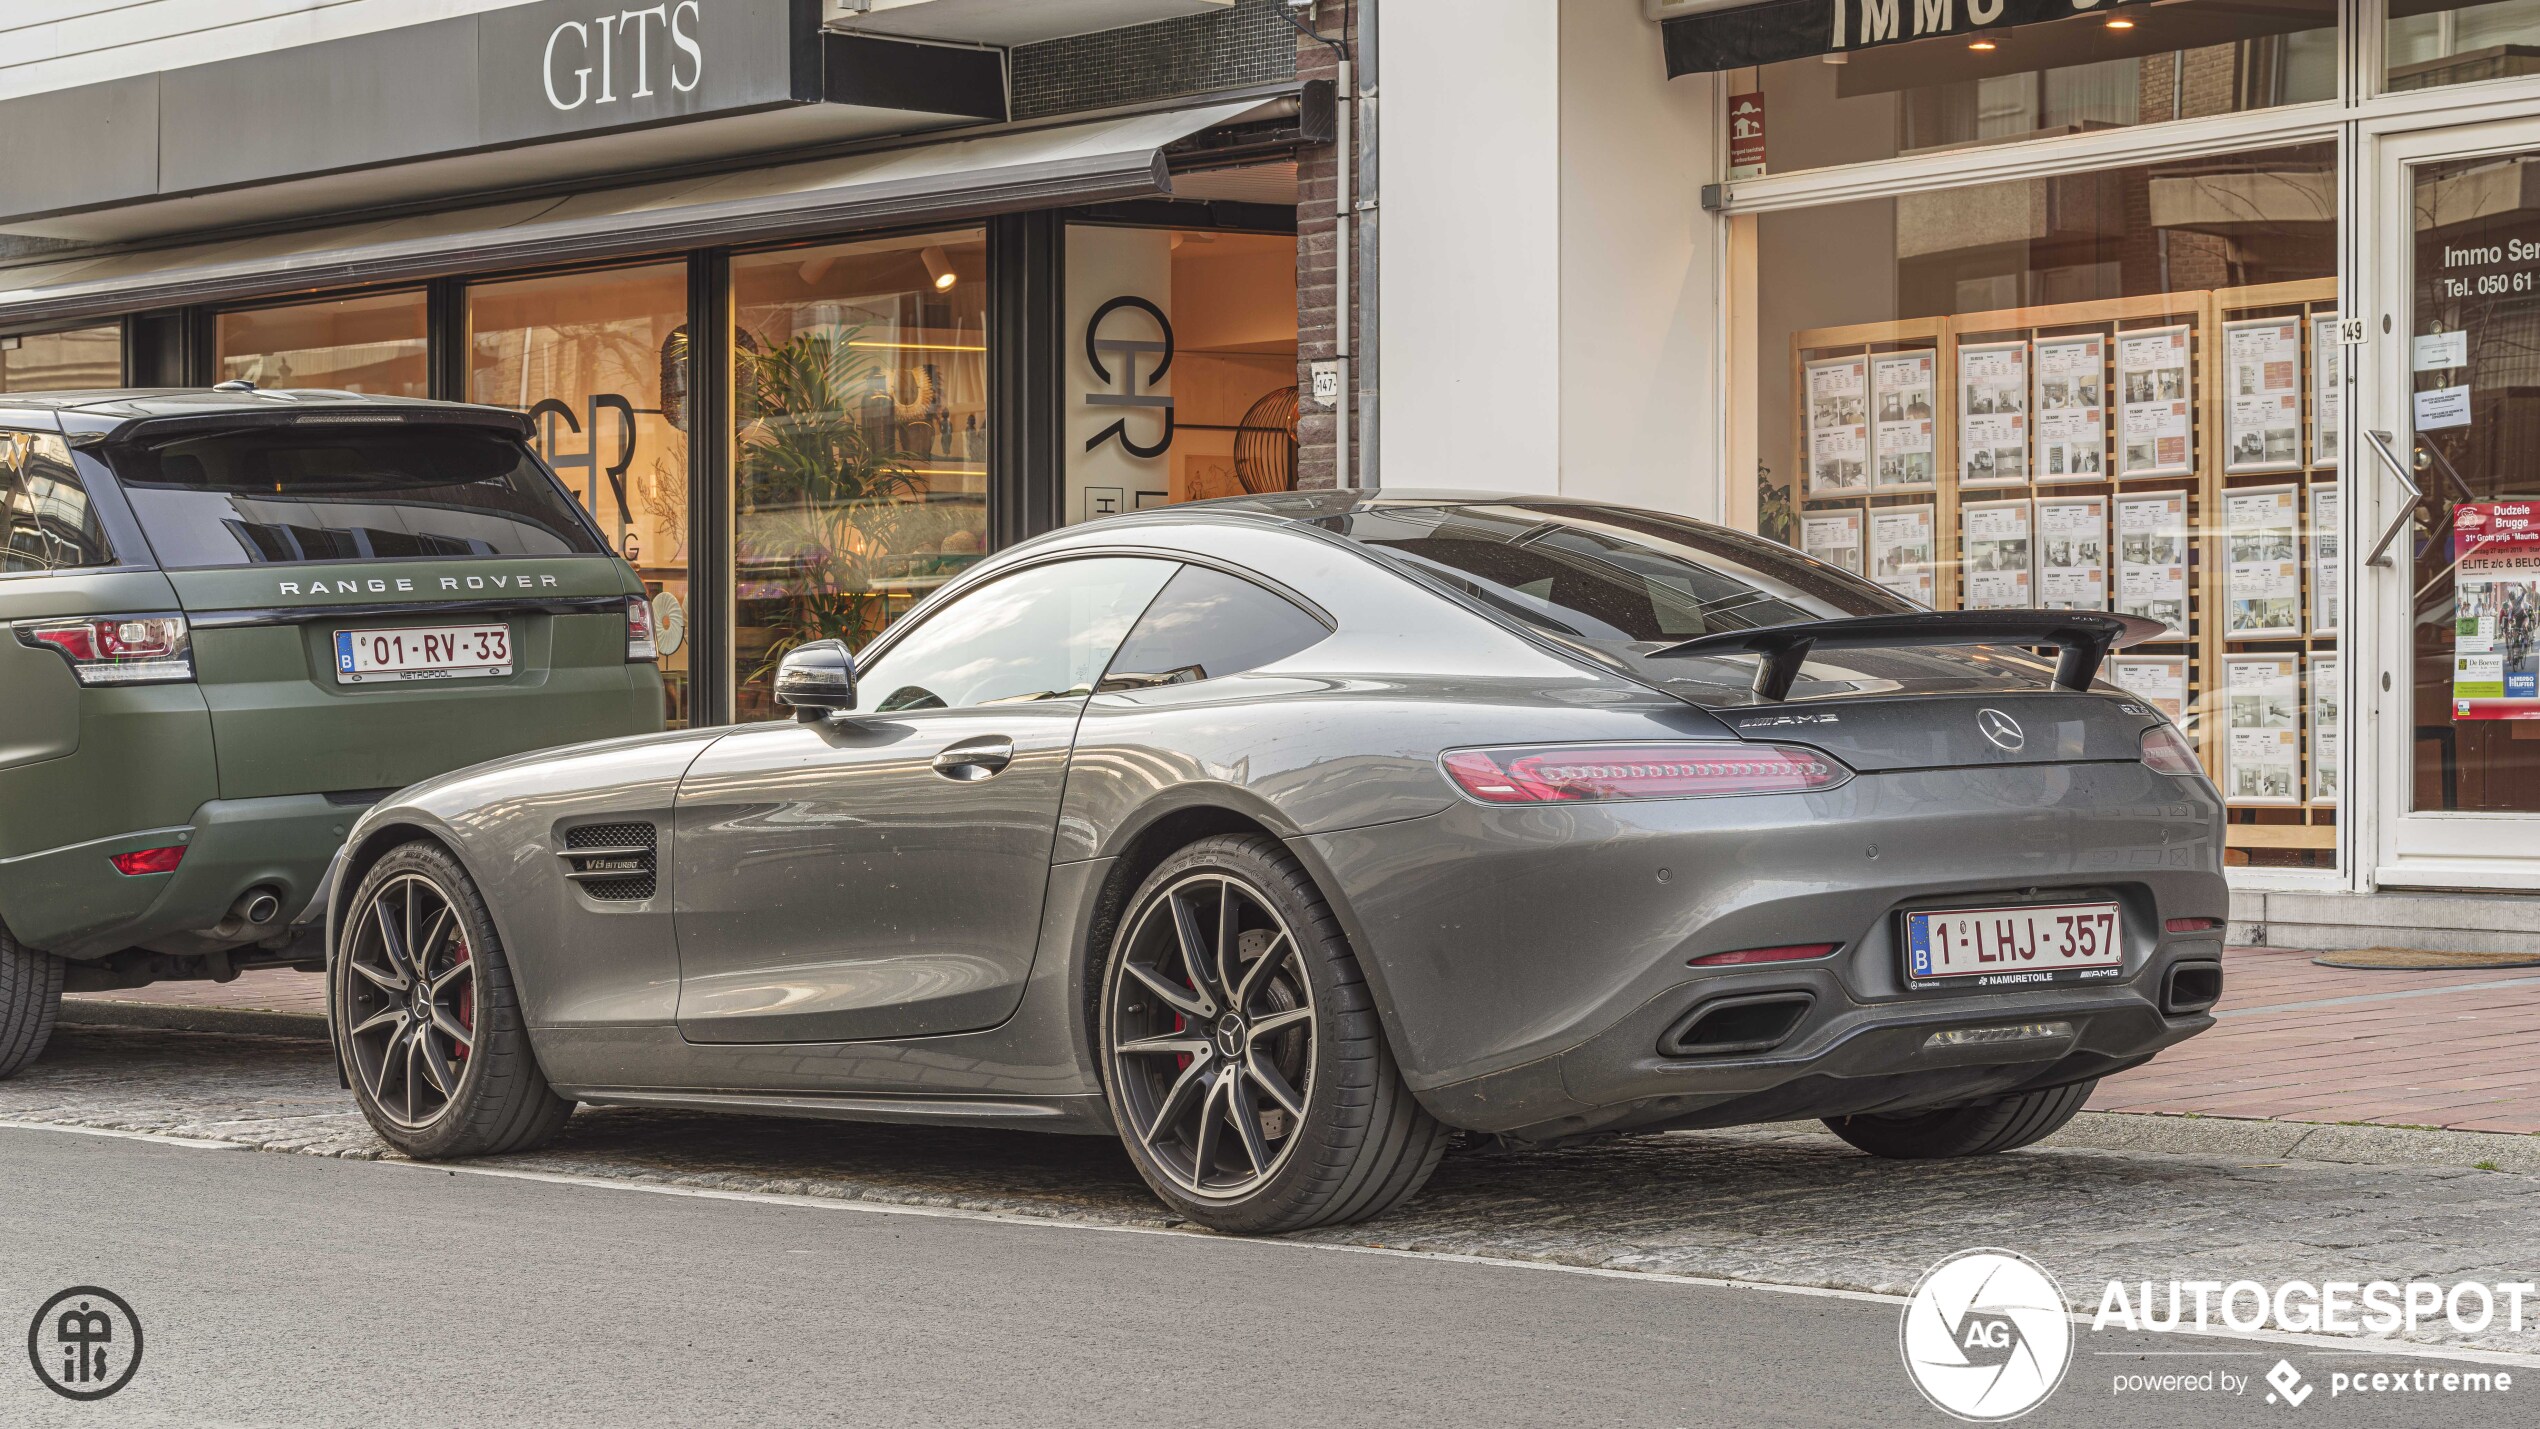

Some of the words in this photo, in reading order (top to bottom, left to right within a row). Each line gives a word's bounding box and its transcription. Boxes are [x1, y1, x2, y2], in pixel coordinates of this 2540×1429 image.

[543, 0, 702, 110] GITS
[2445, 246, 2501, 267] Immo
[2444, 278, 2473, 297] Tel.
[2478, 274, 2508, 294] 050
[2513, 272, 2531, 291] 61
[2342, 321, 2362, 341] 149
[1319, 378, 1333, 392] 147
[2494, 505, 2530, 516] Dudzele
[2495, 518, 2529, 530] Brugge
[2477, 533, 2495, 542] Grote
[2496, 533, 2511, 543] prijs
[2498, 546, 2509, 555] april
[2462, 559, 2489, 570] ELITE
[2491, 558, 2504, 569] z/c
[2506, 558, 2513, 568] &
[280, 578, 414, 595] RANGE
[440, 574, 558, 591] ROVER
[341, 655, 352, 669] B
[373, 631, 507, 666] 01-RV-33
[400, 670, 452, 680] METROPOOL
[585, 859, 605, 870] V8
[605, 860, 638, 869] BITURBO
[1915, 950, 1928, 970] B
[1937, 913, 2115, 966] 1-LHJ-357
[1989, 972, 2053, 985] NAMURETOILE
[2092, 969, 2119, 977] AMG
